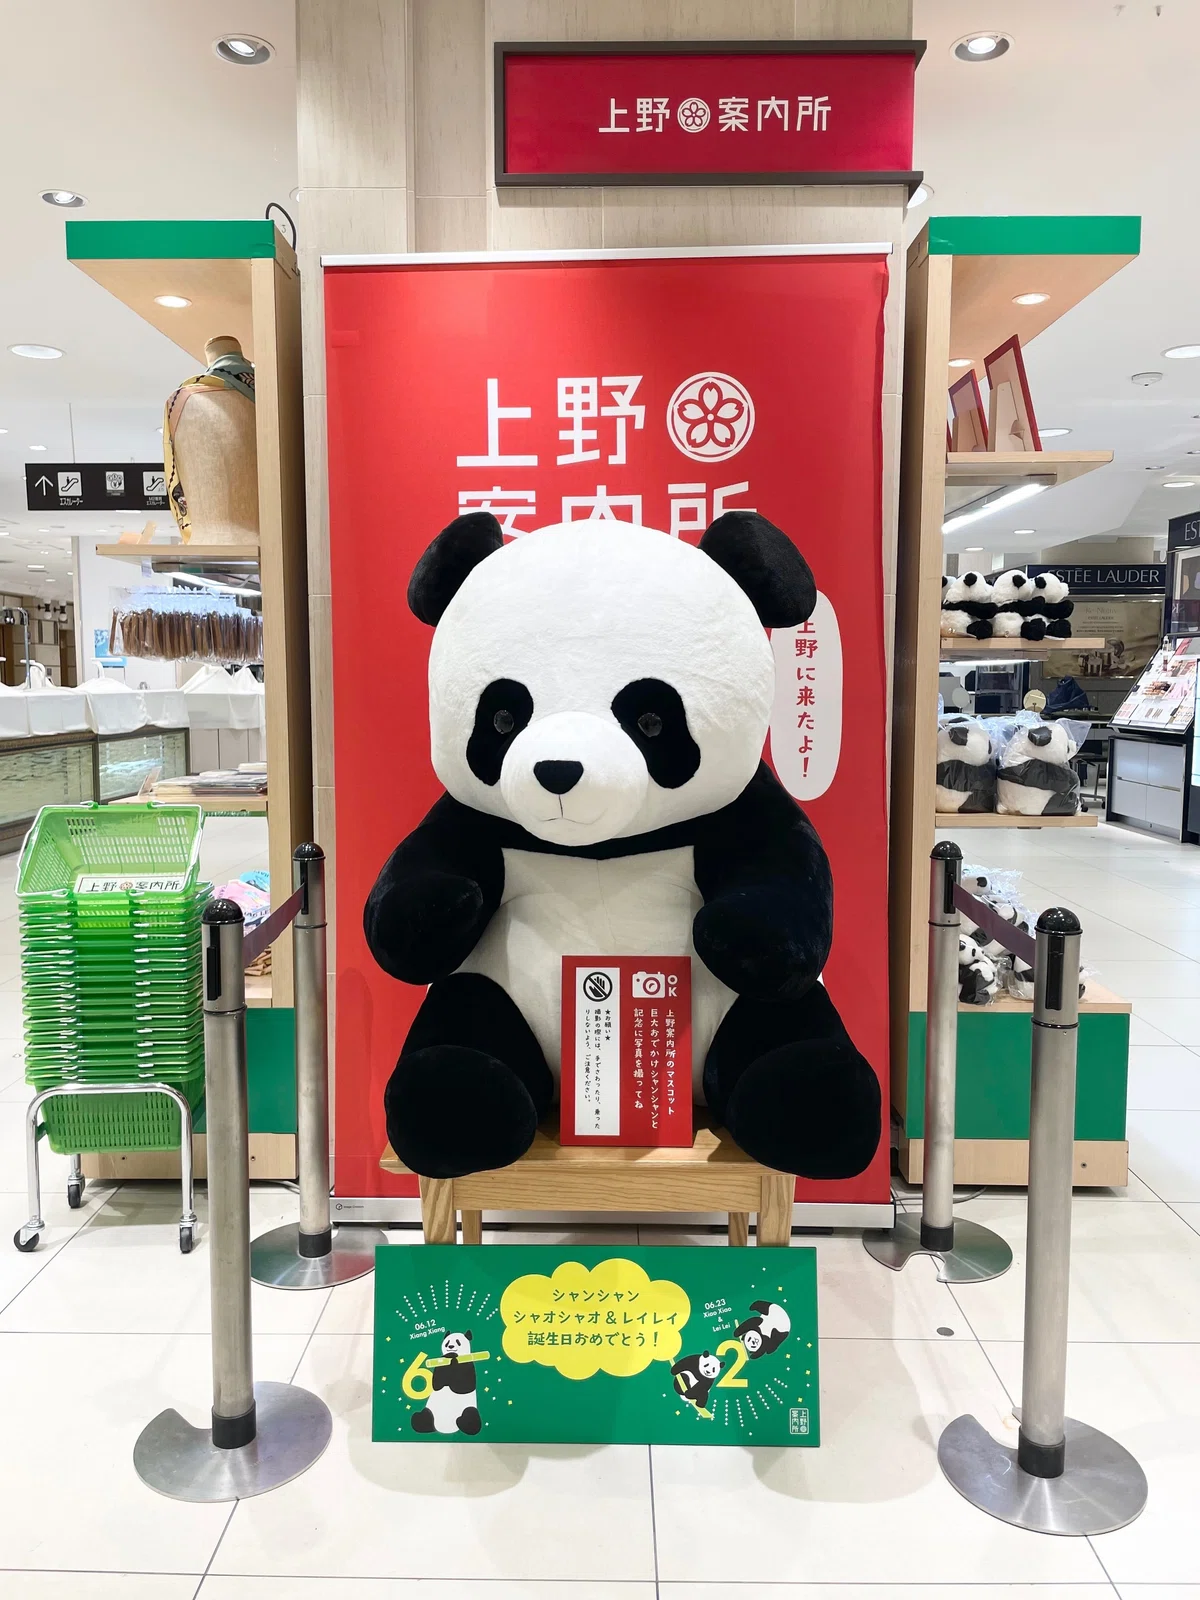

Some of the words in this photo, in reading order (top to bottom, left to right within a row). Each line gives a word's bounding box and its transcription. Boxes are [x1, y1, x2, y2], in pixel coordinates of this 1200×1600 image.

[598, 97, 670, 133] 上野
[718, 95, 832, 132] 案内所
[457, 375, 645, 467] 上野
[1097, 569, 1160, 584] LAUDER
[795, 619, 818, 777] 上野に来たよ！
[86, 881, 117, 892] 上野
[633, 1007, 644, 1109] 記念に写真を撮ってね
[665, 1008, 676, 1115] 上野案内所のマスコット
[650, 1008, 660, 1129] 巨大おでかけシャンシャンと
[552, 1289, 640, 1303] シャンシャン
[704, 1298, 726, 1310] 06.23
[703, 1309, 717, 1318] Xiao
[718, 1307, 732, 1315] Xiao
[410, 1330, 427, 1340] Xiang
[428, 1326, 445, 1336] Xiang
[414, 1319, 436, 1331] 06.12
[712, 1324, 721, 1332] Lei
[722, 1323, 731, 1331] Lei
[527, 1331, 659, 1347] 誕生日おめでとう！
[715, 1339, 749, 1388] 2
[402, 1351, 433, 1400] 6
